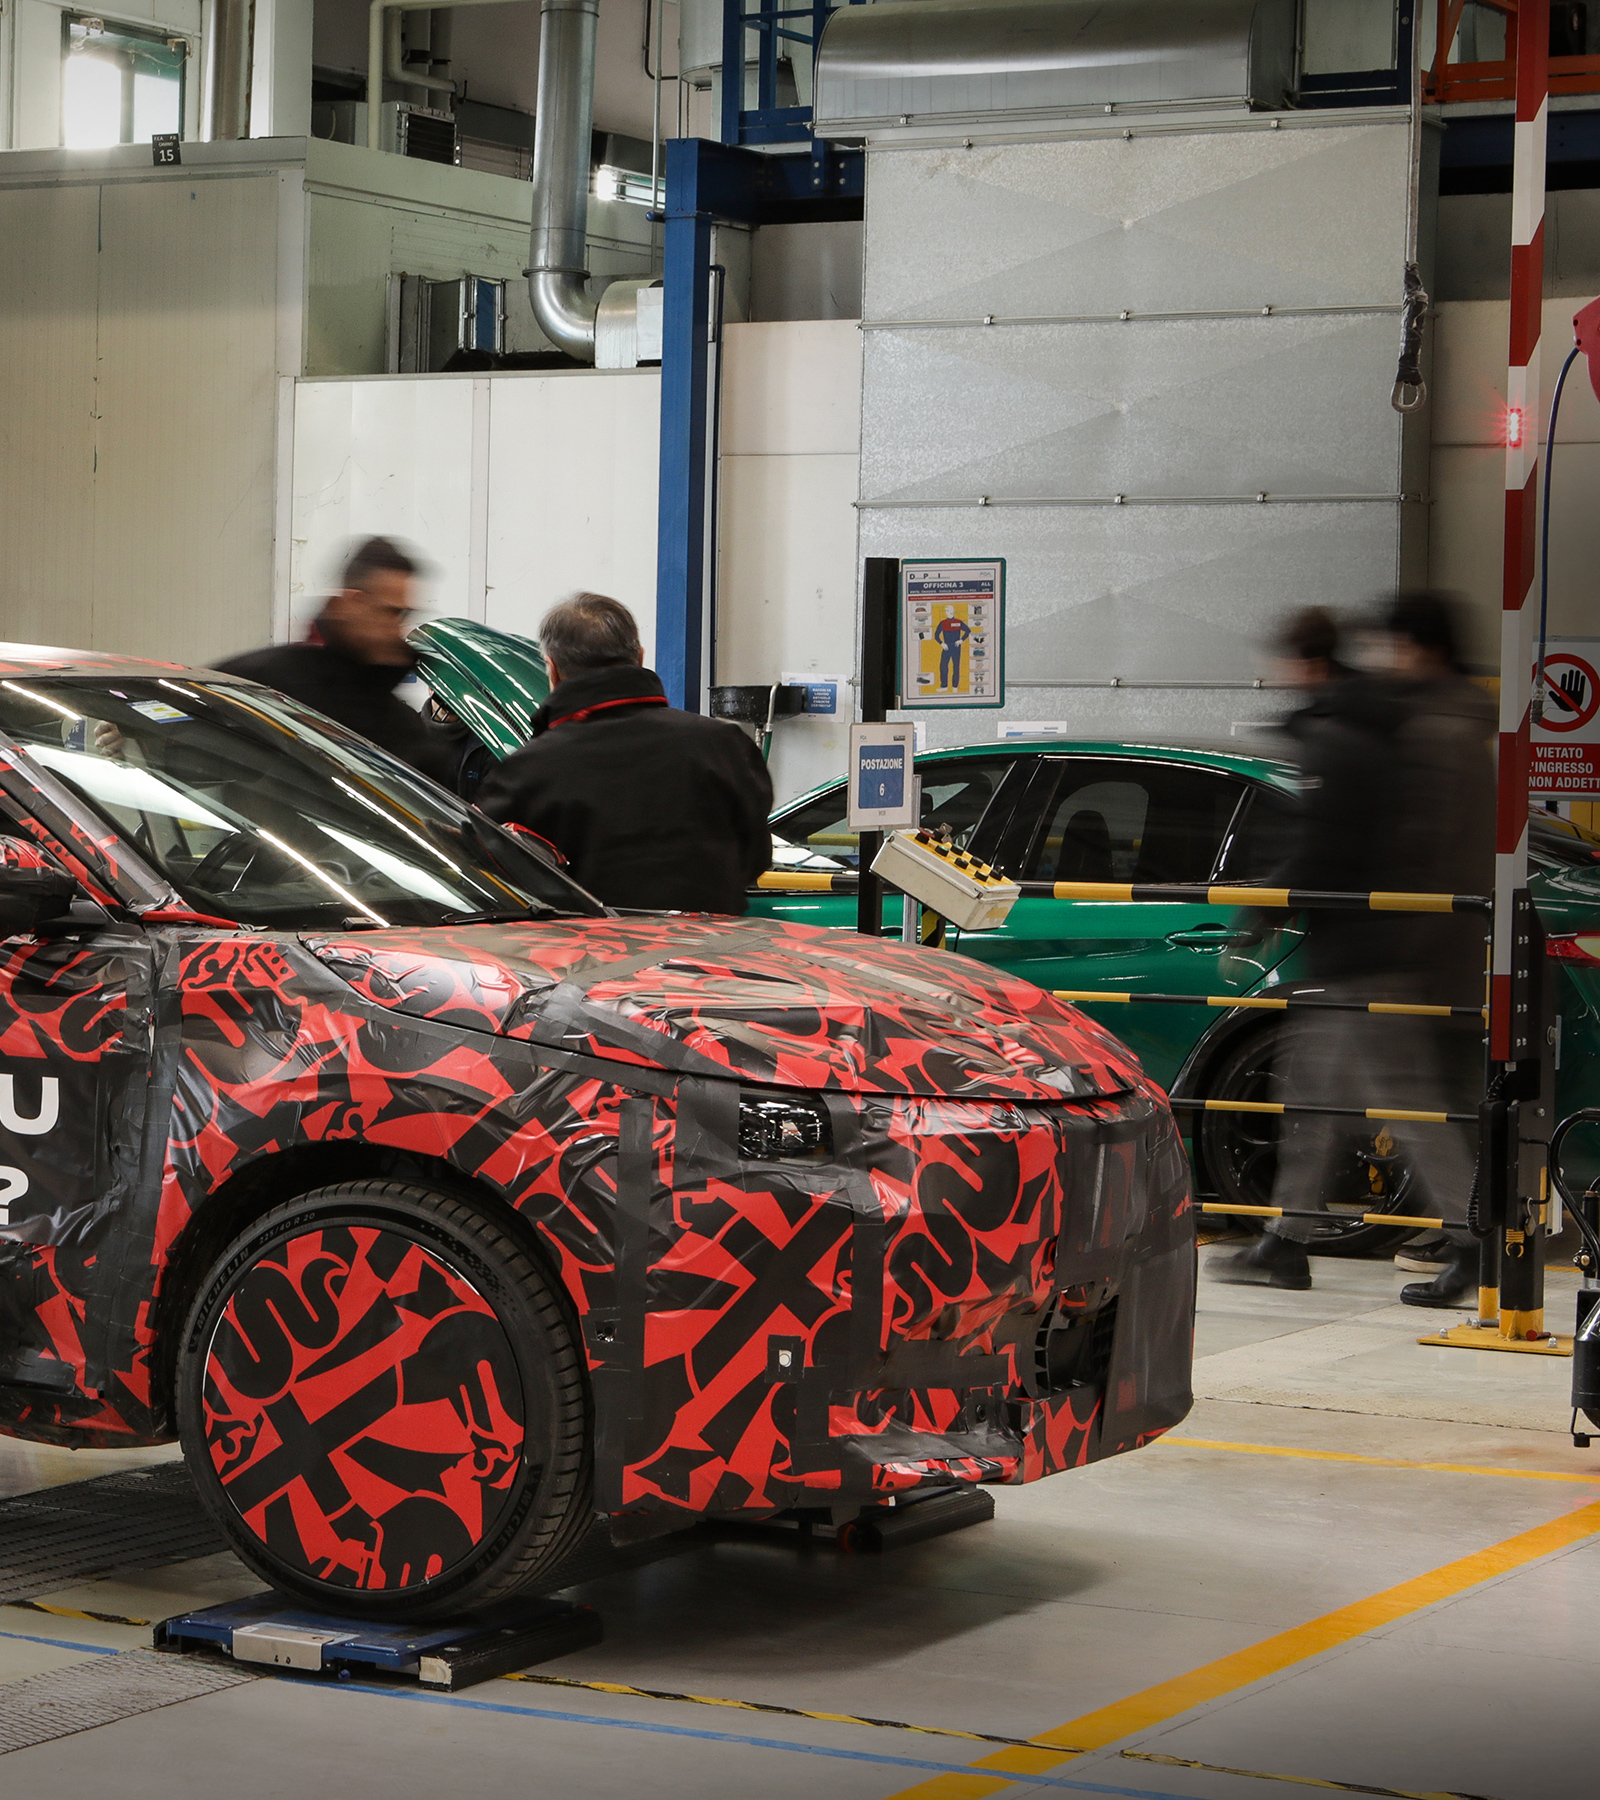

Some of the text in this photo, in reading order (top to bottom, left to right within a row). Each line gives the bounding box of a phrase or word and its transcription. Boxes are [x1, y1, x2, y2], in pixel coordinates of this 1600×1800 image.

[159, 149, 175, 162] 15
[1535, 746, 1584, 759] VIETATO
[860, 758, 903, 770] POSTAZIONE
[1528, 761, 1594, 774] 'INGRESSO
[1528, 776, 1553, 788] NON
[879, 783, 885, 796] 6
[194, 1210, 316, 1329] MICHELIN 225/40 R 20
[471, 1487, 533, 1572] MICHELIN
